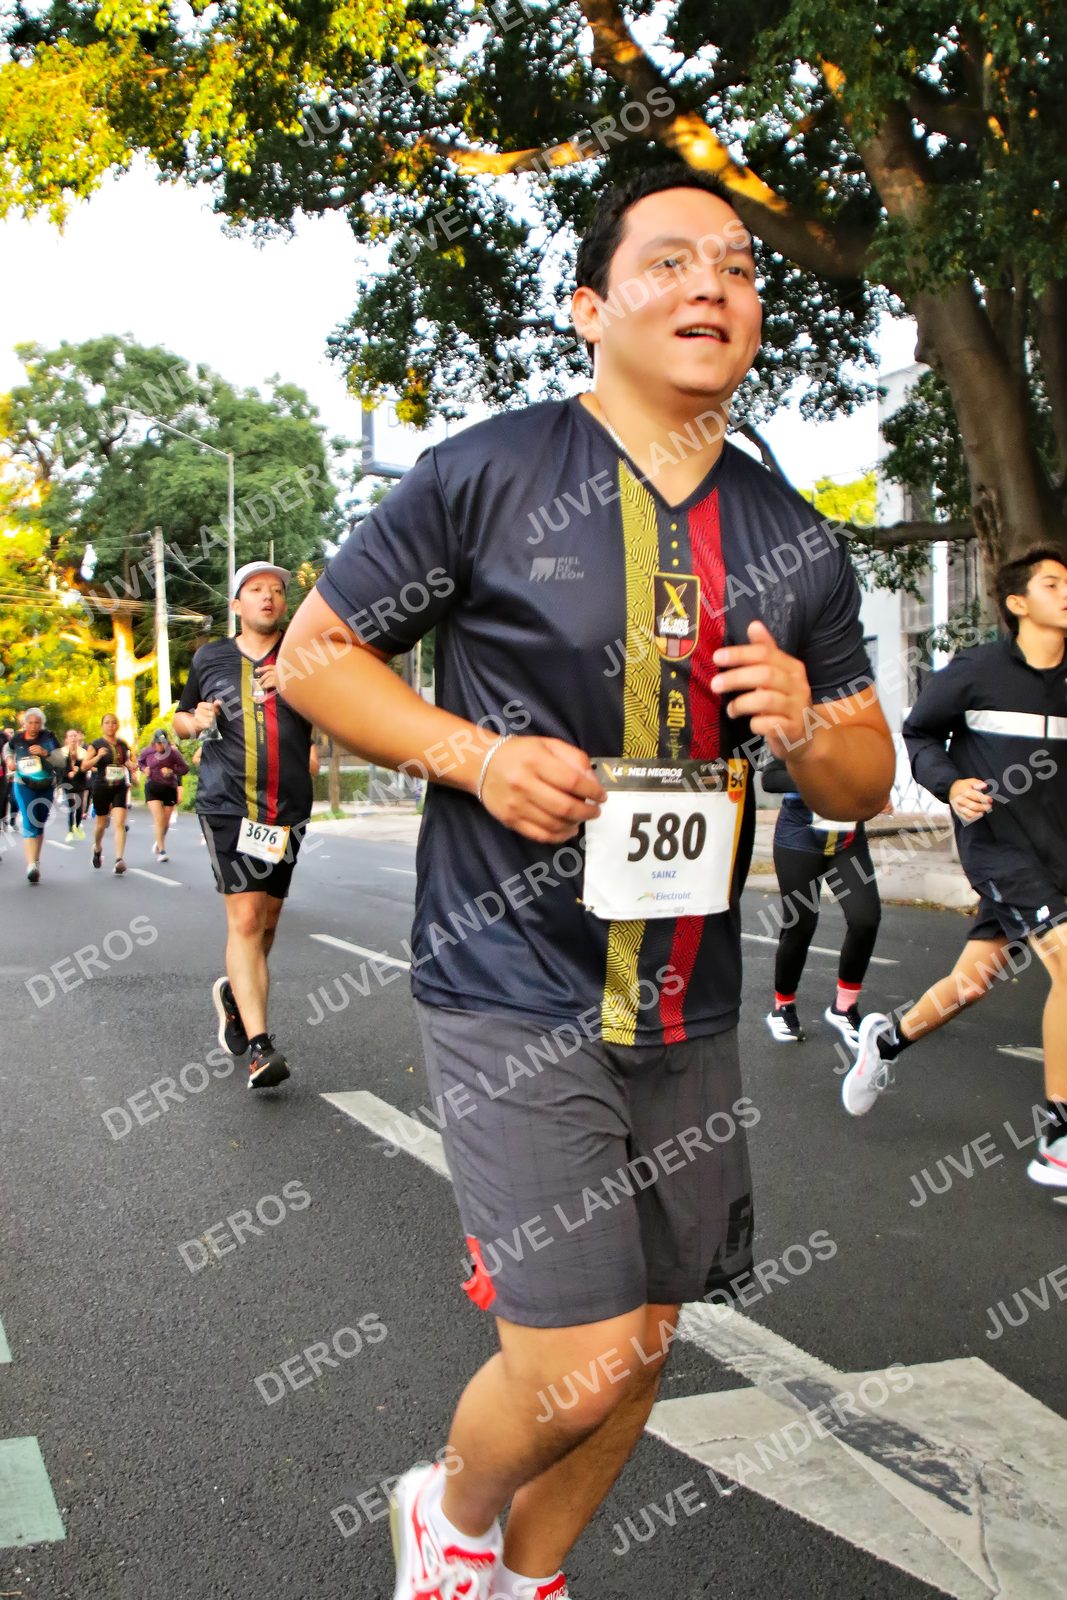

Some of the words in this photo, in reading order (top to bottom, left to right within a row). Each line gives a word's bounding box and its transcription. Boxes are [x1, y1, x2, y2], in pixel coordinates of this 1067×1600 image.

[647, 767, 683, 778] NEGROS
[246, 822, 278, 845] 3676
[627, 812, 707, 862] 580
[651, 870, 677, 879] SAINZ
